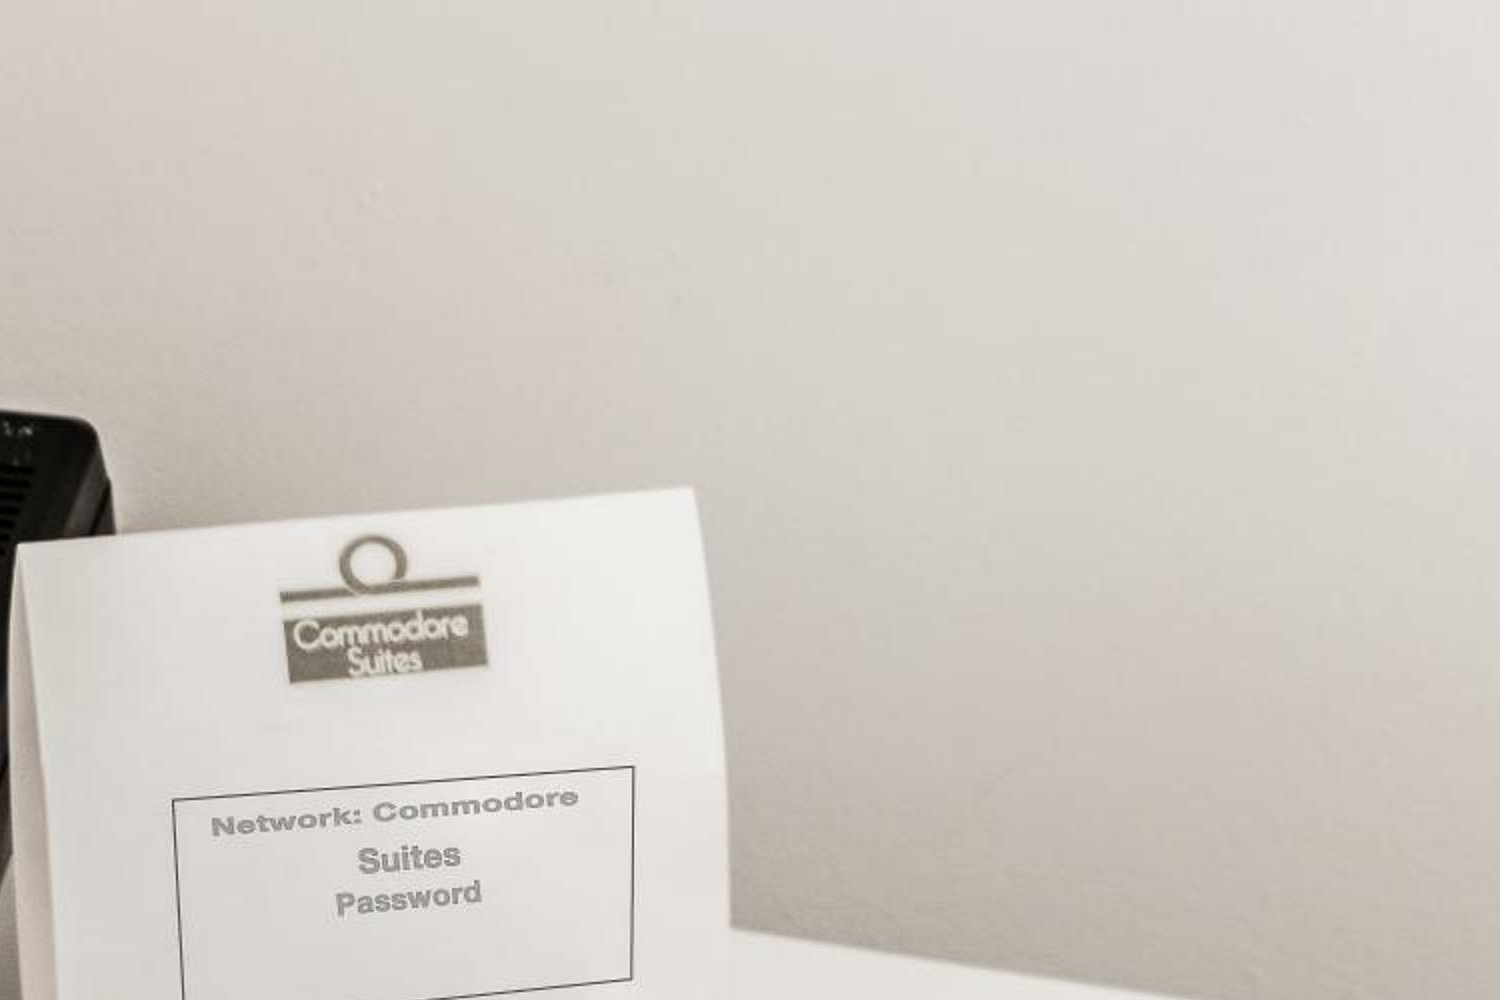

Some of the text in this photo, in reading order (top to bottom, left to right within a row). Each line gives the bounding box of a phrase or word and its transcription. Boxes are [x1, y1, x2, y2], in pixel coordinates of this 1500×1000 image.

[293, 610, 469, 651] Commodore
[347, 646, 423, 678] Suites
[210, 786, 581, 838] Network: Commodore
[357, 845, 462, 876] Suites
[335, 880, 483, 917] Password
